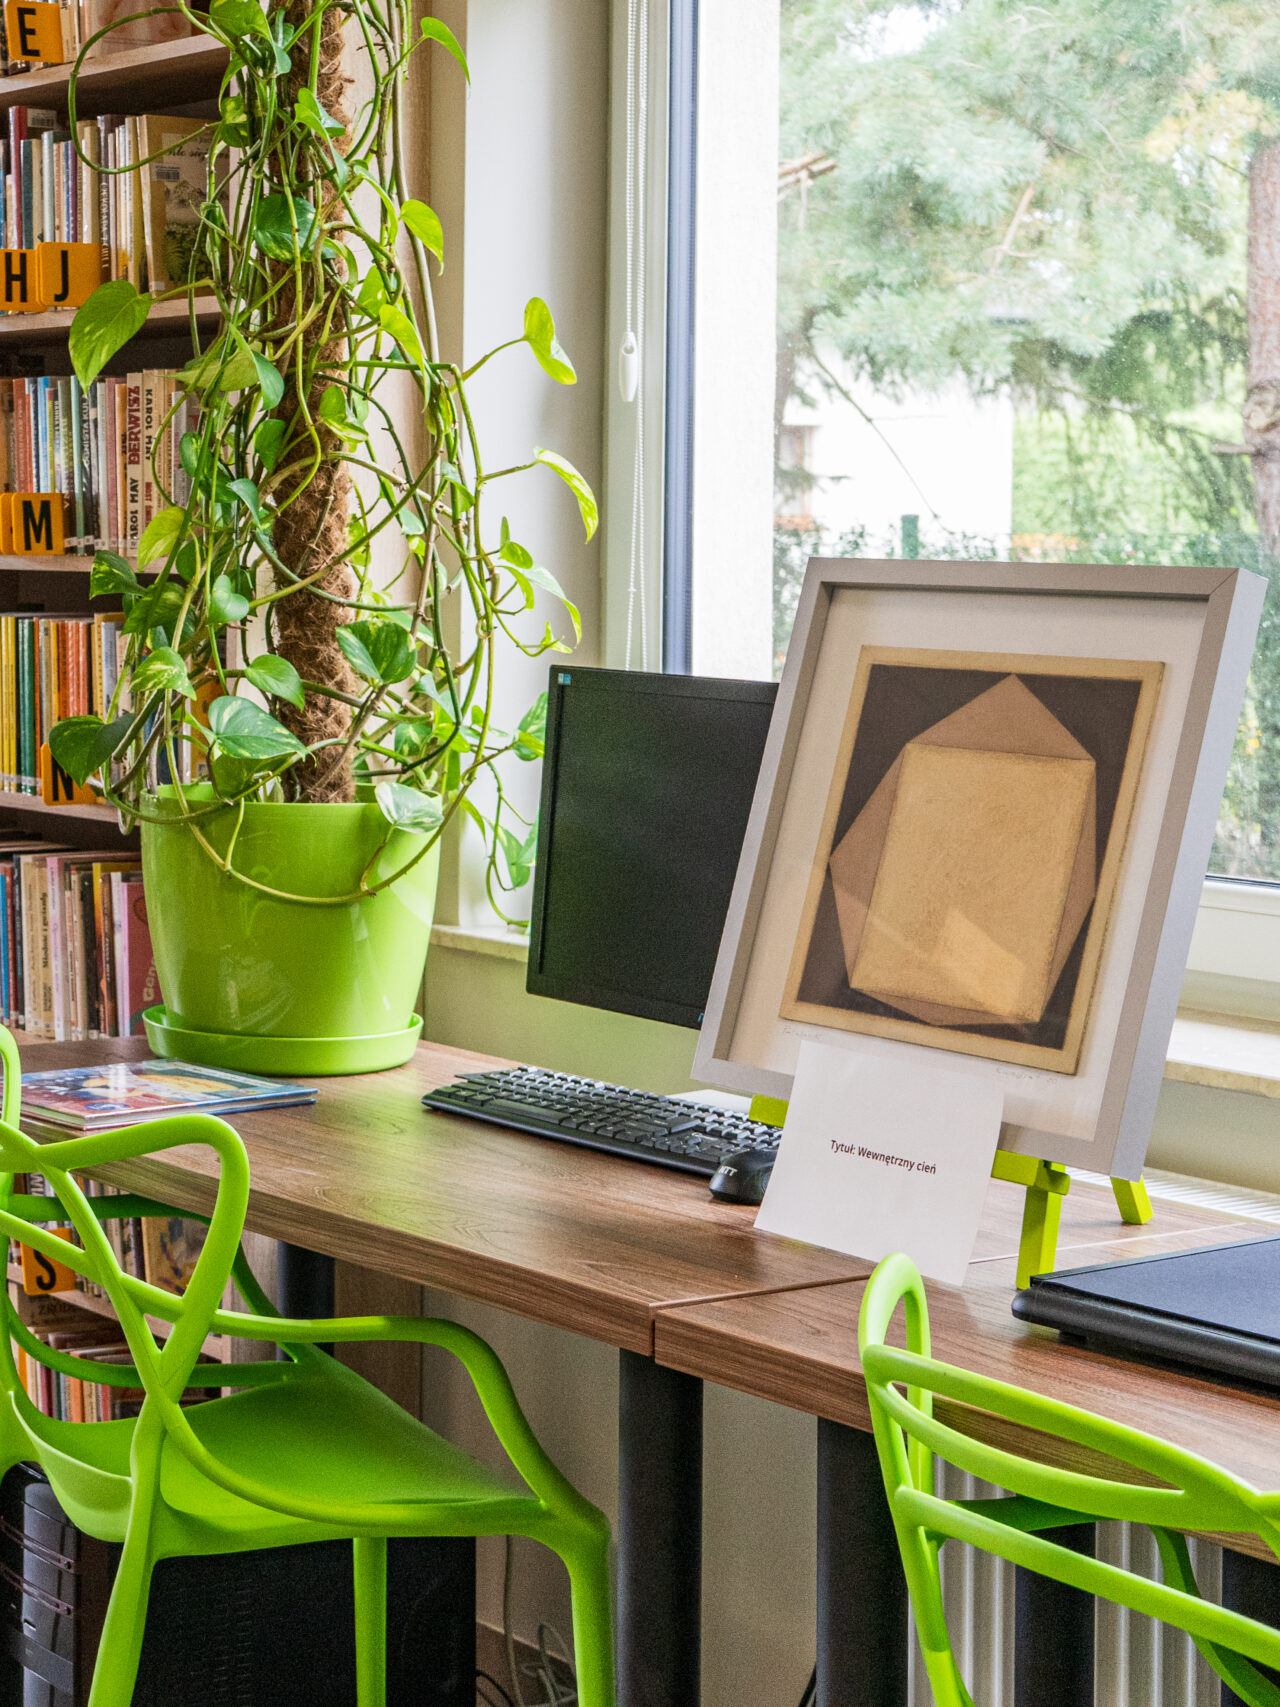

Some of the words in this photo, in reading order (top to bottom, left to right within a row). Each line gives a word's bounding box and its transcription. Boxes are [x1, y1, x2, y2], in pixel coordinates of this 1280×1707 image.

[17, 6, 41, 57] E
[4, 251, 28, 304] H
[53, 249, 70, 303] J
[127, 385, 141, 465] DERWISZ
[145, 388, 153, 430] KAROL
[129, 477, 139, 503] MAY
[22, 500, 53, 551] M
[129, 509, 139, 540] AROL
[831, 1139, 856, 1155] Tytuł:
[857, 1145, 915, 1172] Wewnętrzny
[916, 1161, 937, 1175] cień
[32, 1248, 57, 1291] S
